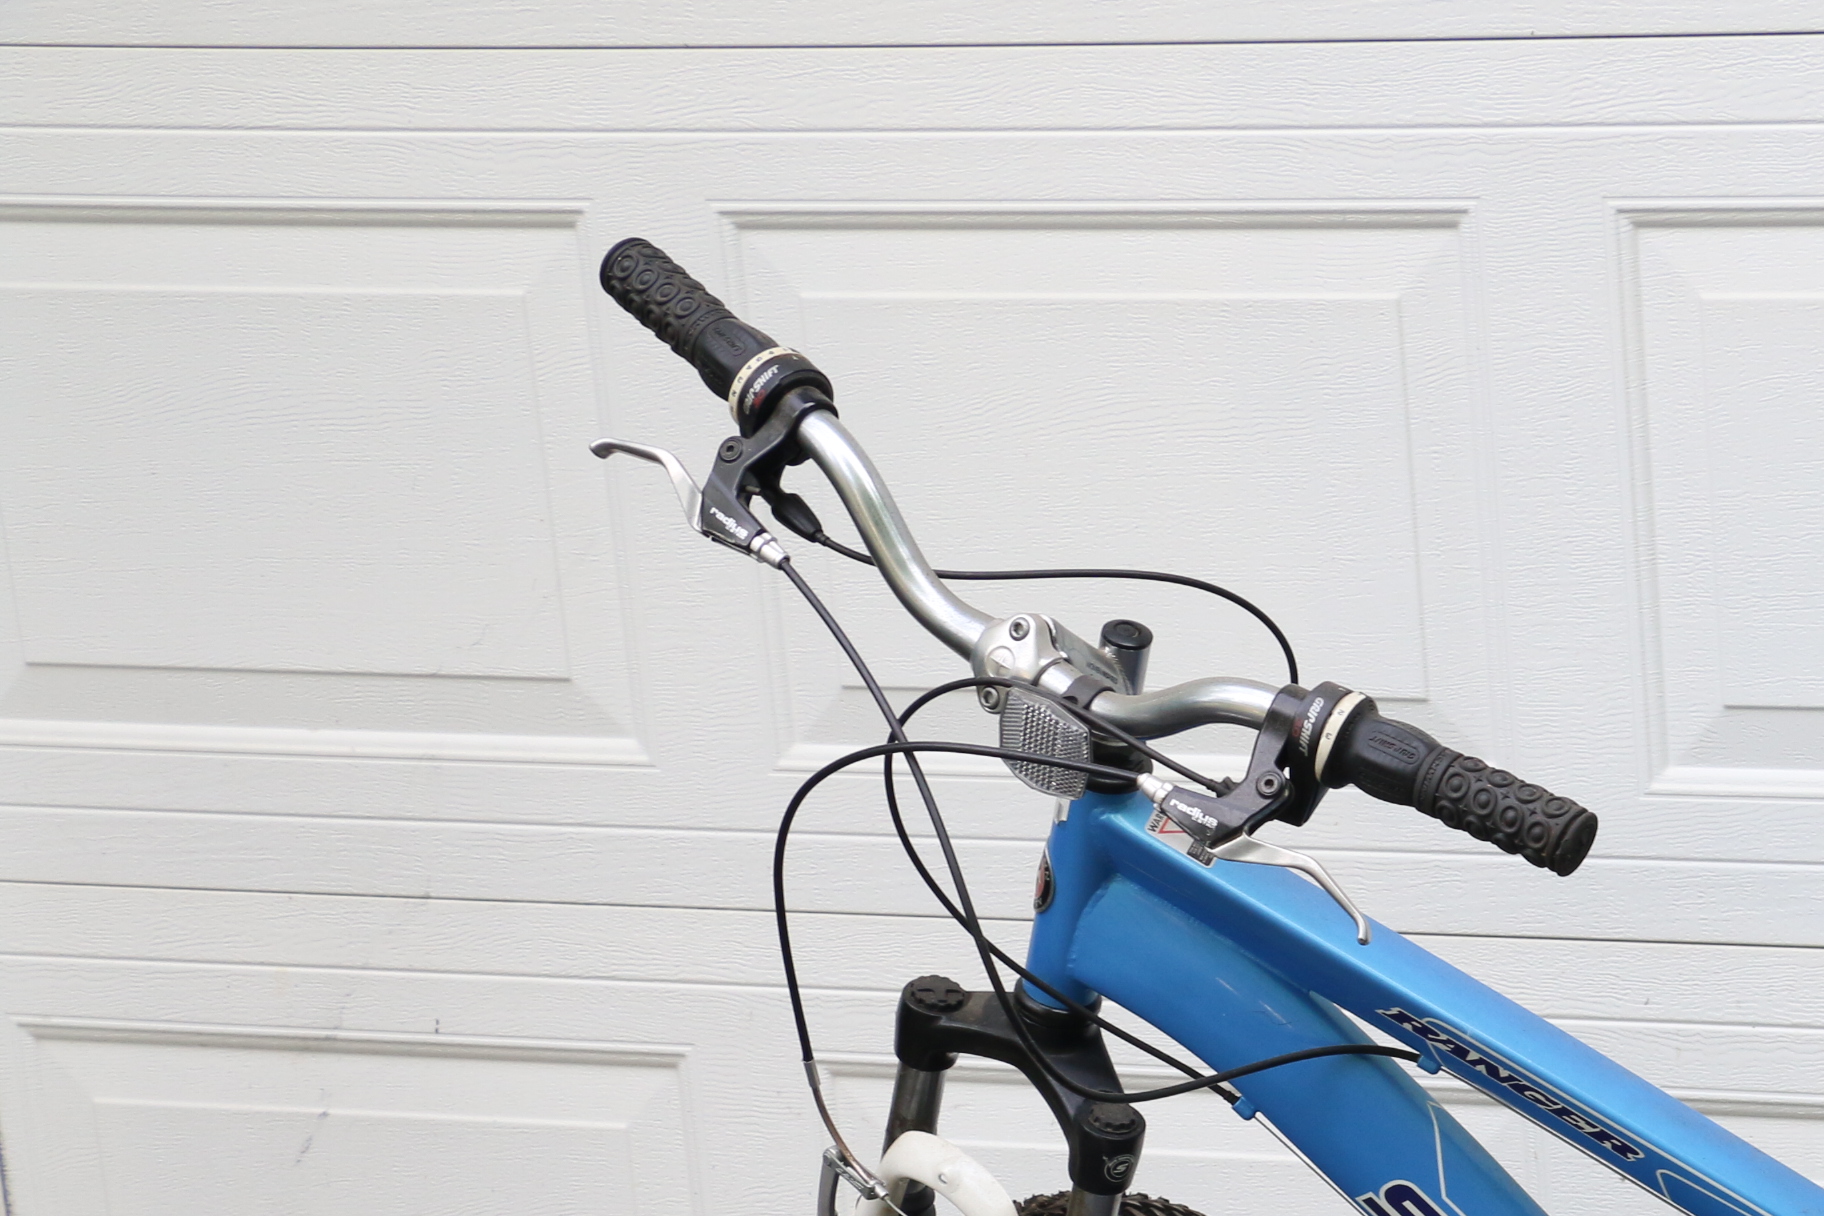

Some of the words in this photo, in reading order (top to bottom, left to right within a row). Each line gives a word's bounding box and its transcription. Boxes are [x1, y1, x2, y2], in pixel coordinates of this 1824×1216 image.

[709, 506, 749, 539] radius
[1169, 798, 1219, 828] radius
[1375, 1007, 1645, 1162] RANGER
